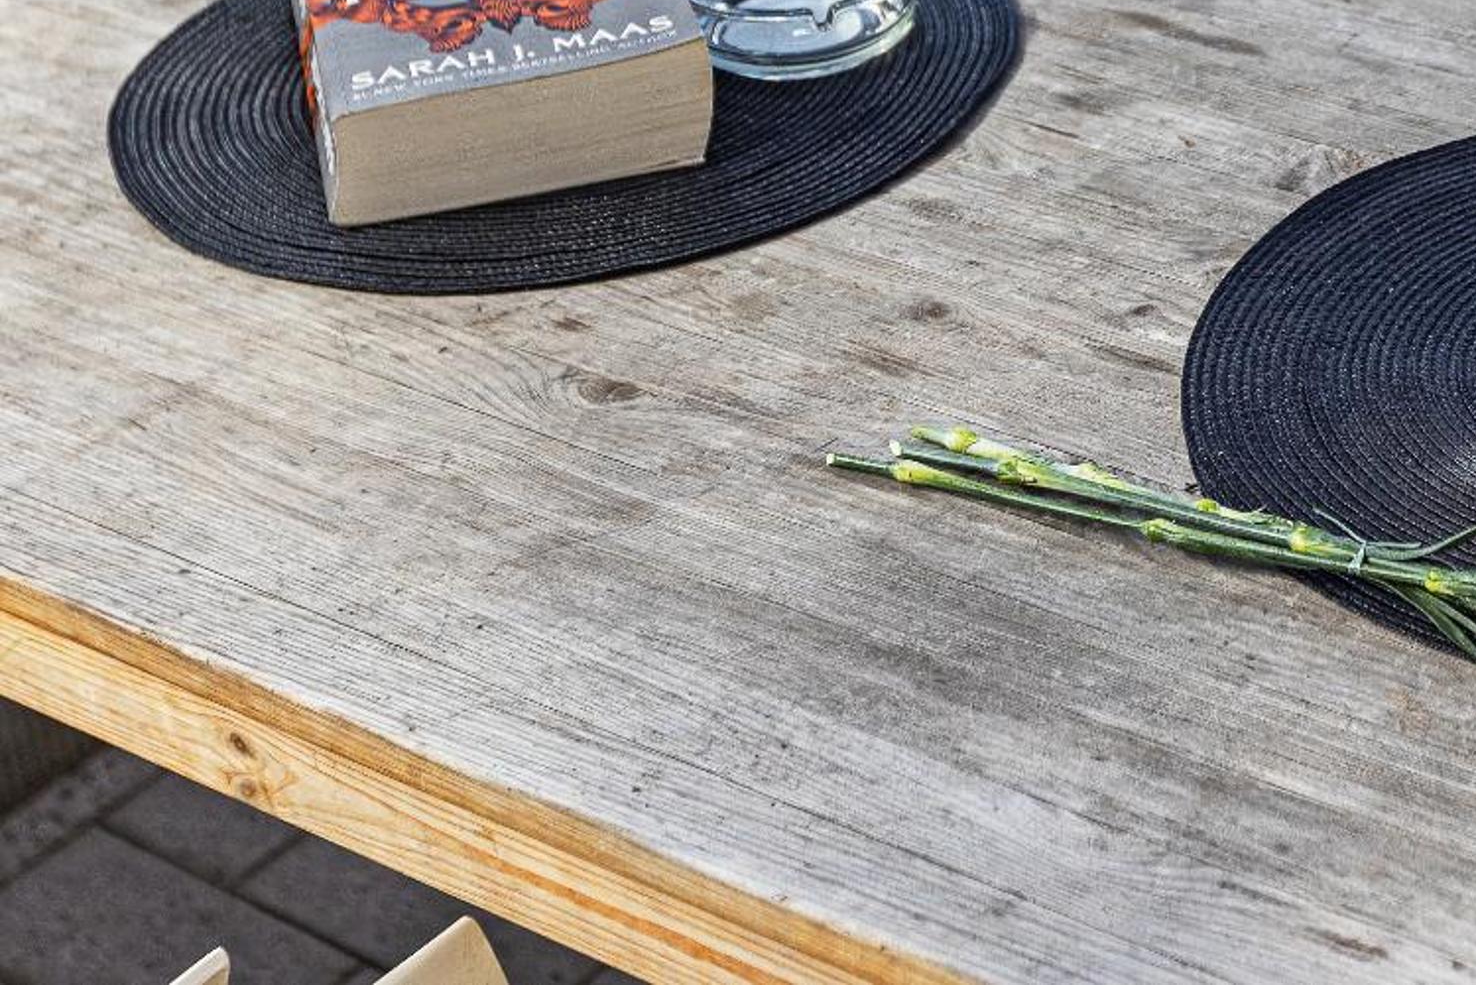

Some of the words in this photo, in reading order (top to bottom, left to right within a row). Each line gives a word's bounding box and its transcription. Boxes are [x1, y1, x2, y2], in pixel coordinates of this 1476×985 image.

[351, 48, 496, 90] SARAH
[513, 44, 536, 63] J.
[552, 15, 674, 53] MAAS
